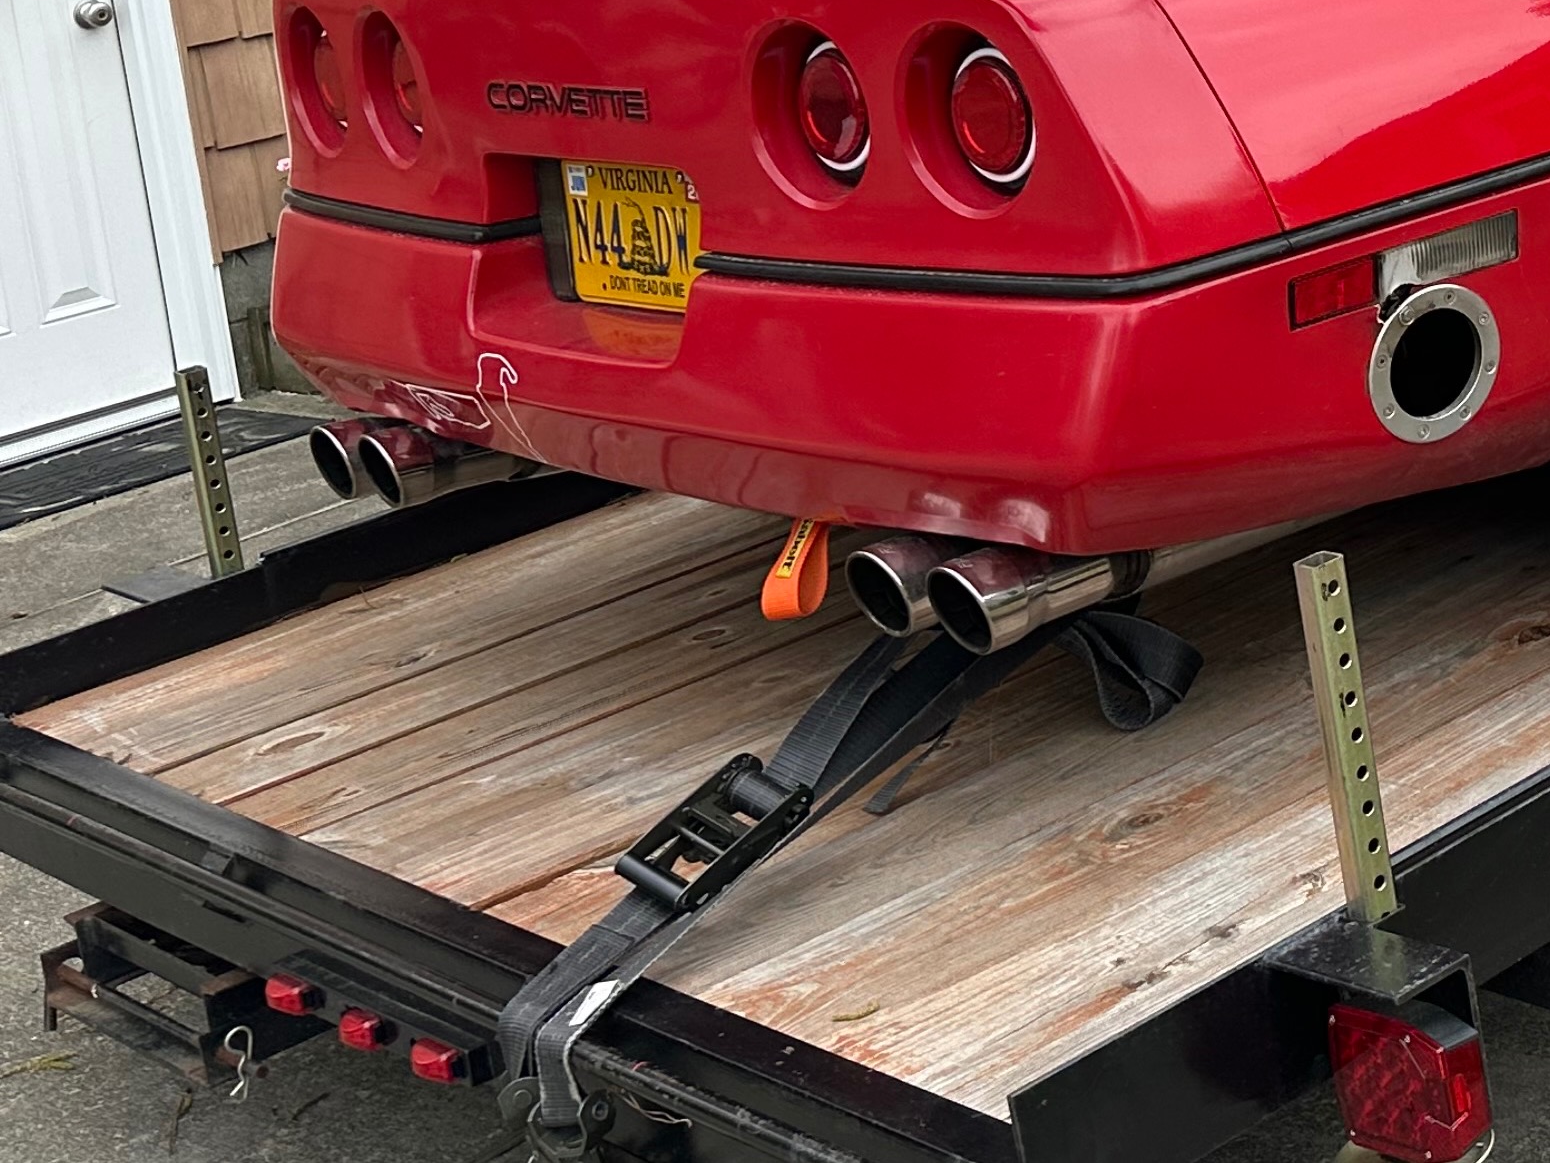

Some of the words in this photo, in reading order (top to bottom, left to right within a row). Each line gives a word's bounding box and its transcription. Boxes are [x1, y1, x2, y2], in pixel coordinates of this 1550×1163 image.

[486, 81, 648, 121] CORVETTE
[598, 166, 673, 195] VIRGINIA
[632, 276, 659, 295] TREAD
[659, 280, 672, 297] ON
[672, 282, 686, 298] ME
